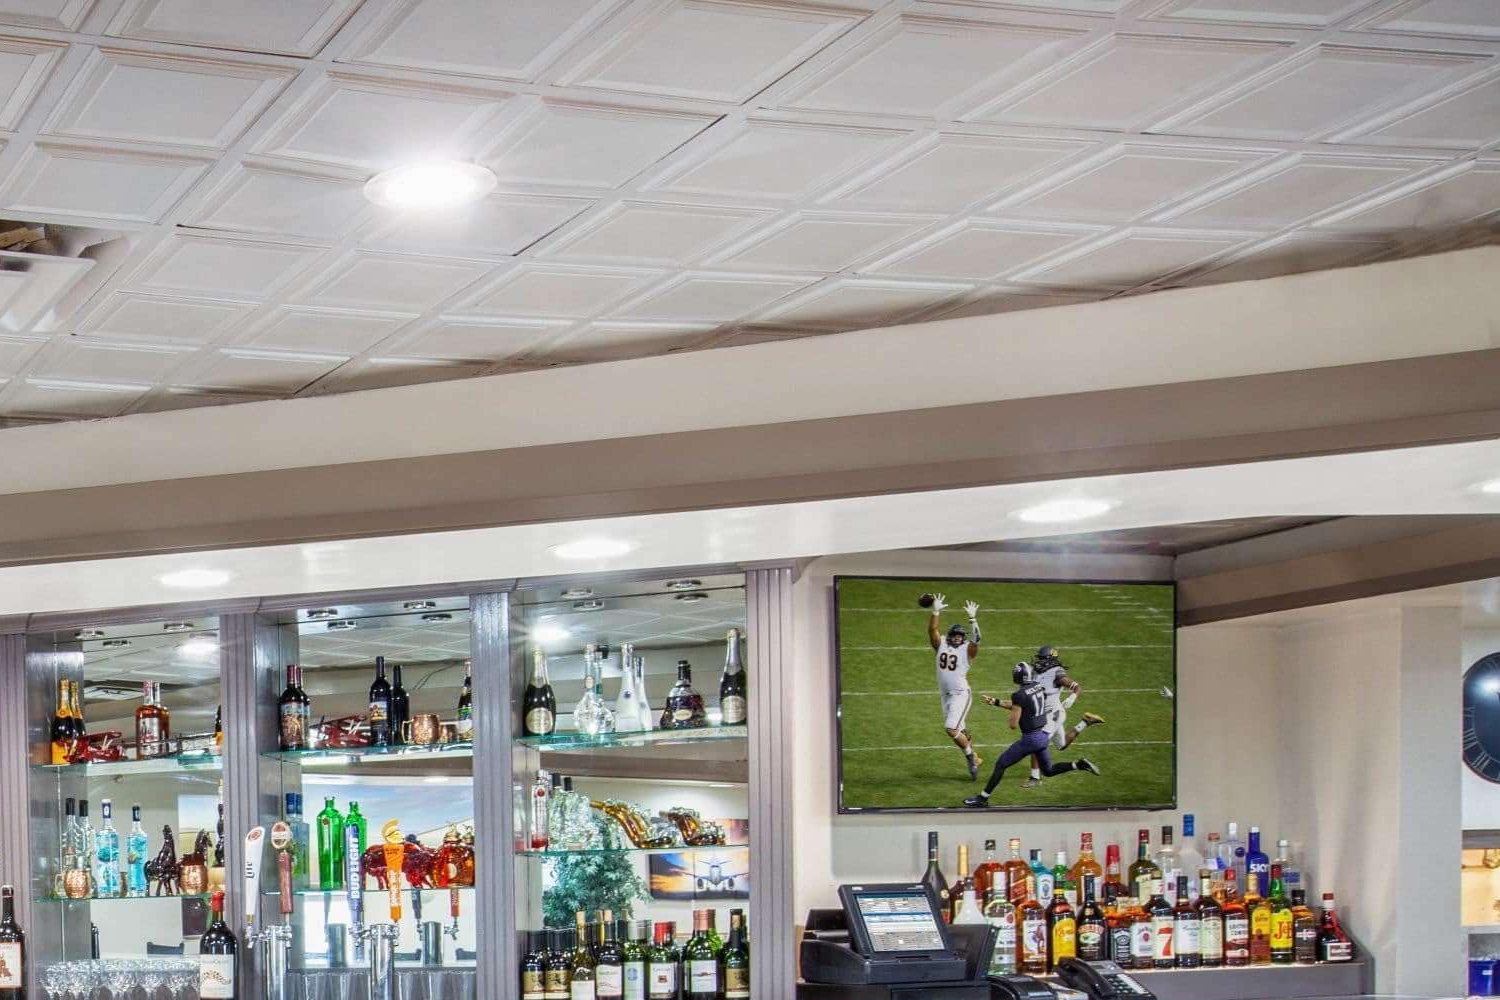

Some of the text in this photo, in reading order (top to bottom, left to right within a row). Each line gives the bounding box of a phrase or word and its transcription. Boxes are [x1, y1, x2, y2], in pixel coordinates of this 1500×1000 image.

[940, 653, 957, 671] 93
[348, 837, 360, 899] BUD LIGHT
[1156, 926, 1173, 957] 7
